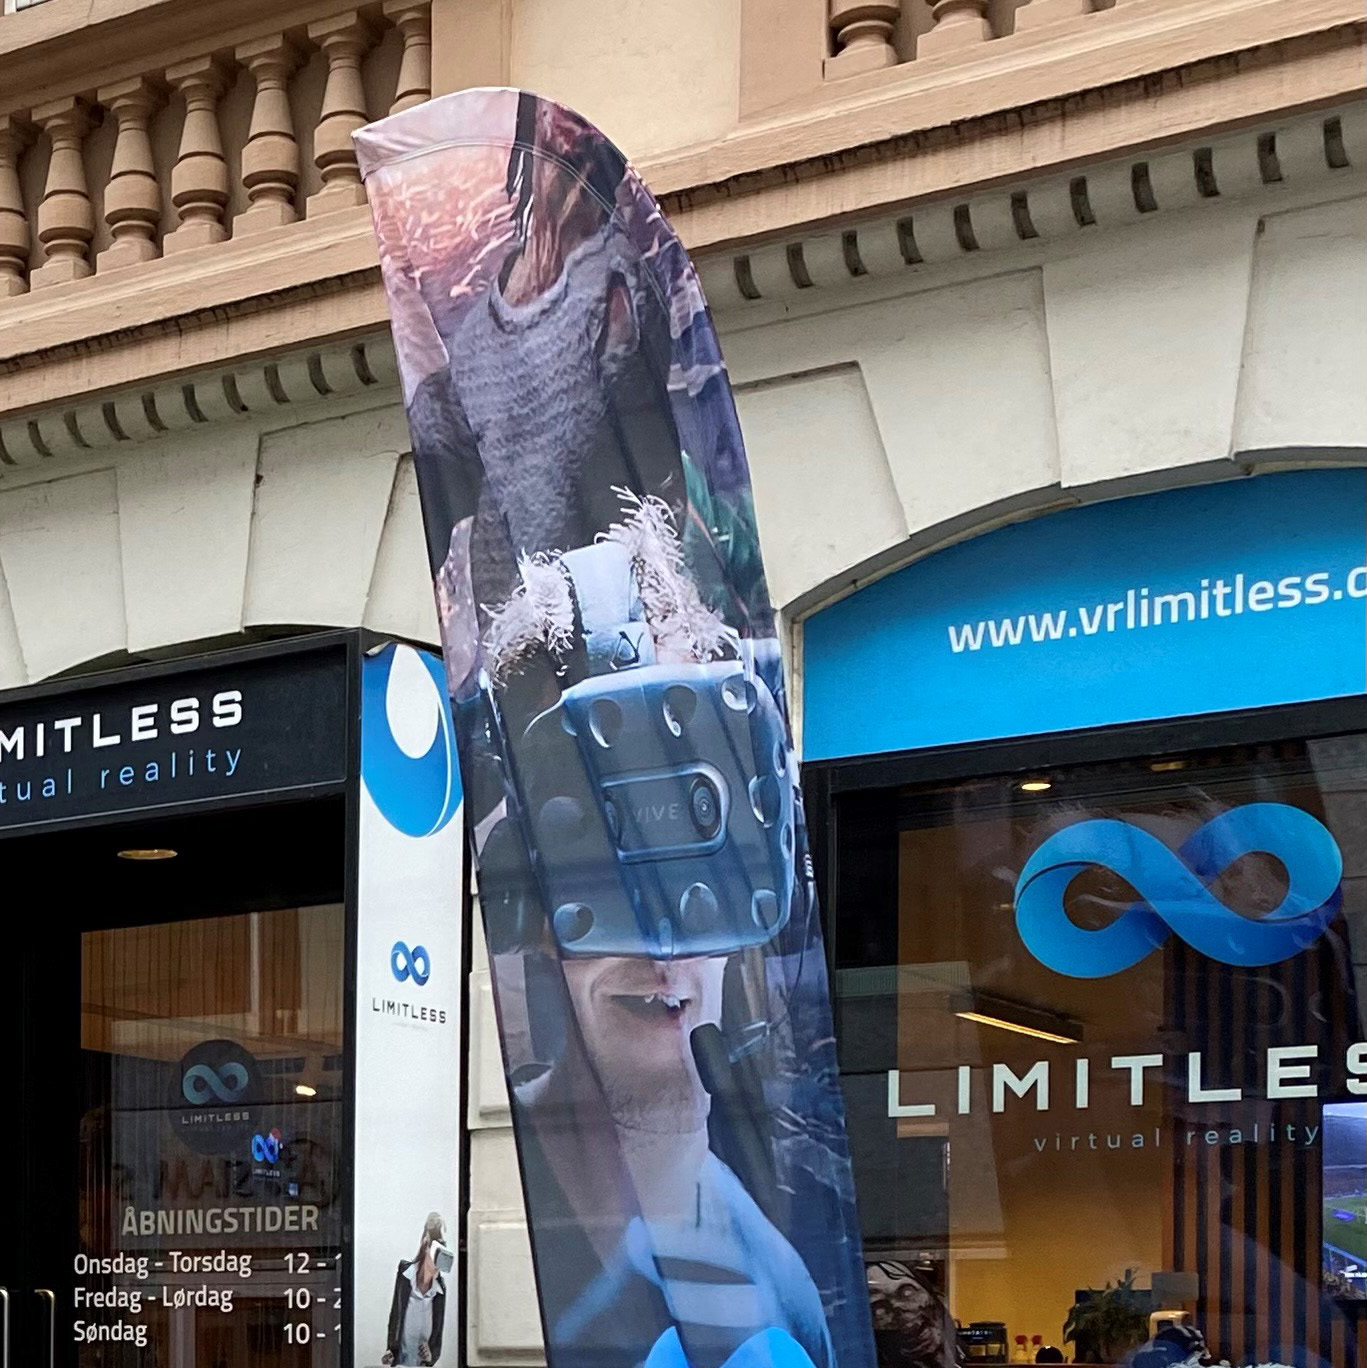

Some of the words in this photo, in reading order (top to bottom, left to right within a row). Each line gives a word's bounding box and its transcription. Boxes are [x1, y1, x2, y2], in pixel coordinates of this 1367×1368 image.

[948, 566, 1367, 654] www.vrlimitless.
[101, 749, 242, 789] reality
[372, 997, 447, 1024] LIMITLESS
[887, 1042, 1367, 1118] LIMITLE
[182, 1112, 250, 1124] LIMITLESS
[1035, 1128, 1160, 1152] virtual
[1186, 1123, 1320, 1147] reality
[121, 1205, 319, 1236] ÅBNINGSTIDER
[73, 1252, 149, 1279] Onsdag
[169, 1250, 252, 1278] Torsdag
[283, 1252, 310, 1274] 12
[73, 1286, 142, 1313] Fredag
[162, 1285, 233, 1312] Lørdag
[283, 1288, 311, 1309] 10
[73, 1320, 148, 1346] Søndag
[283, 1322, 311, 1344] 10
